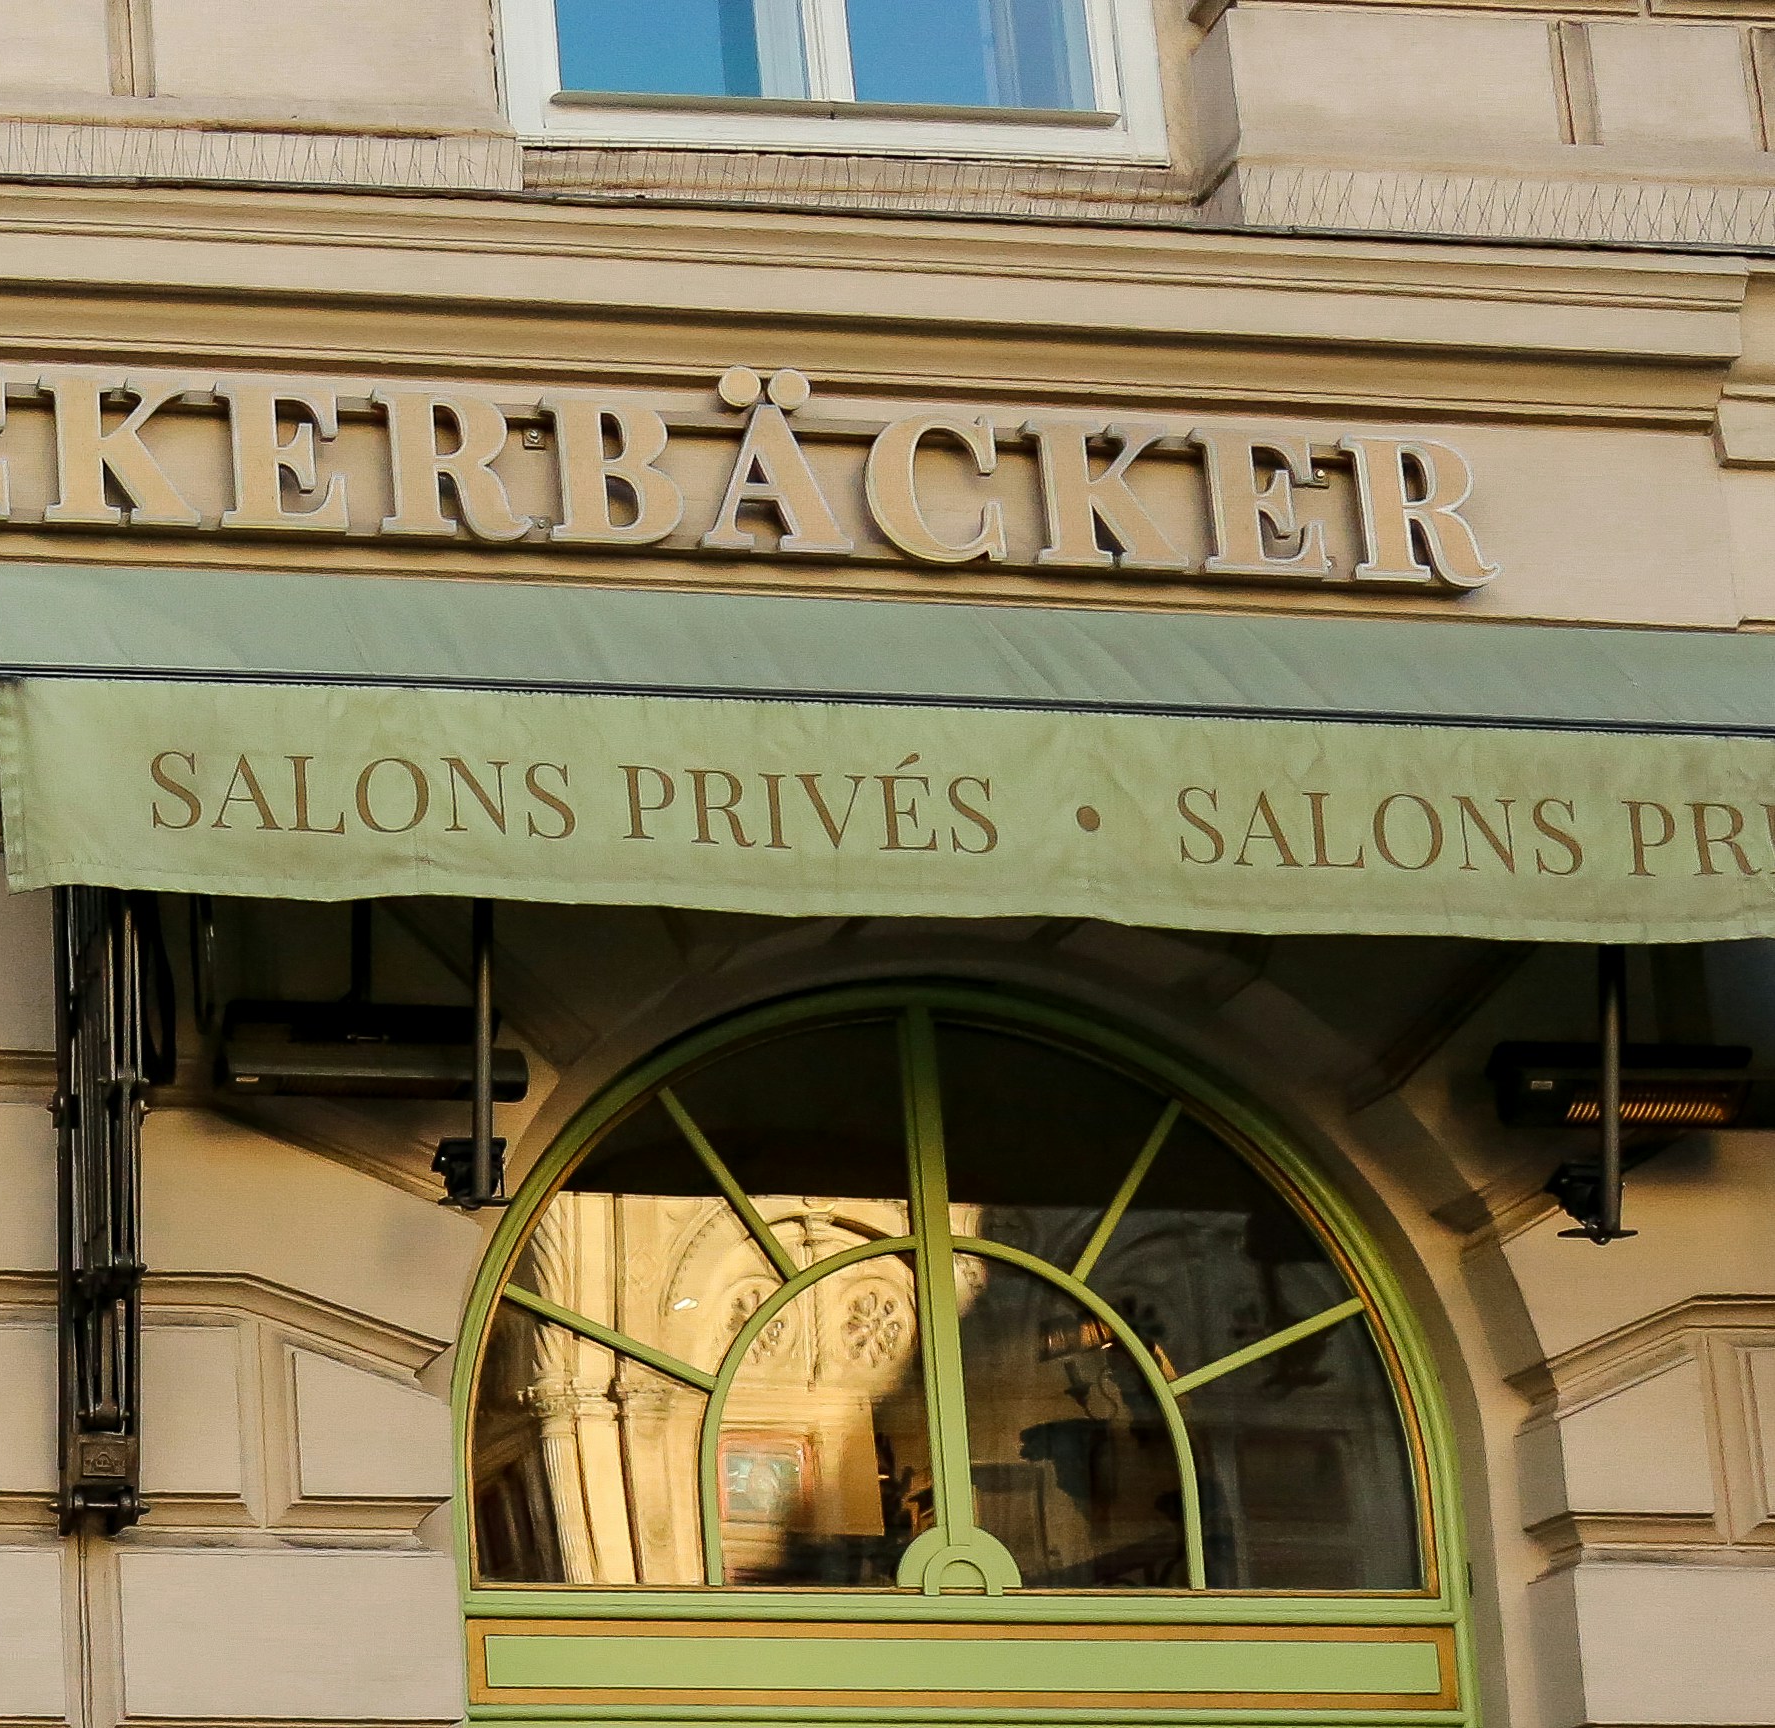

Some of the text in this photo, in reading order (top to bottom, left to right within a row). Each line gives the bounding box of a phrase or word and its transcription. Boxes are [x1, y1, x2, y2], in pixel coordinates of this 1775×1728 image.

[150, 750, 578, 841] SALONS
[619, 753, 998, 855] PRIVÉS
[1178, 787, 1584, 878] SALONS
